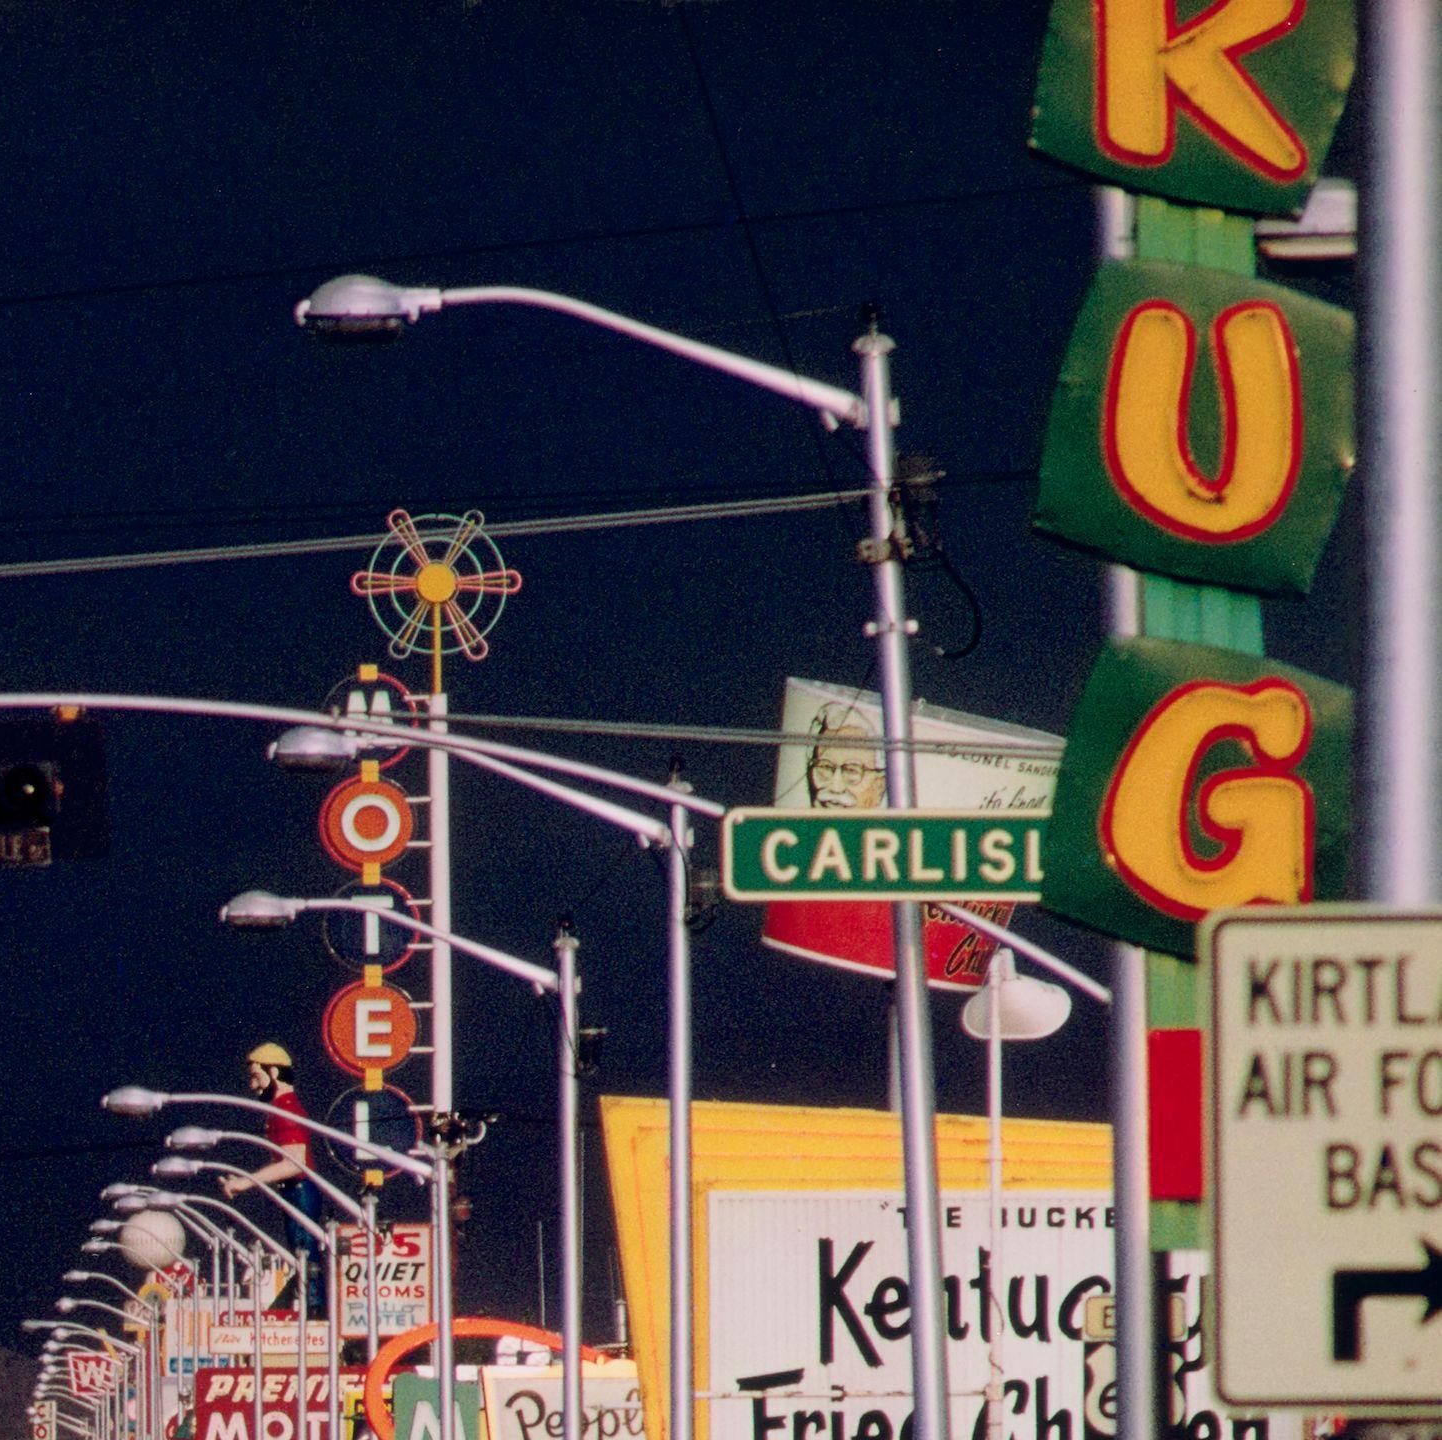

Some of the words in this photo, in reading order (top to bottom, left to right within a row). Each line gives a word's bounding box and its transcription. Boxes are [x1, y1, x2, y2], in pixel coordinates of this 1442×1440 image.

[1248, 957, 1442, 1026] KIRTL
[1238, 1050, 1337, 1120] AIR
[1326, 1143, 1442, 1211] BAS
[346, 1285, 425, 1298] ROOMS
[348, 1314, 421, 1327] MTEL
[249, 1332, 325, 1346] Ktchenetes
[205, 1373, 373, 1403] PREMIE
